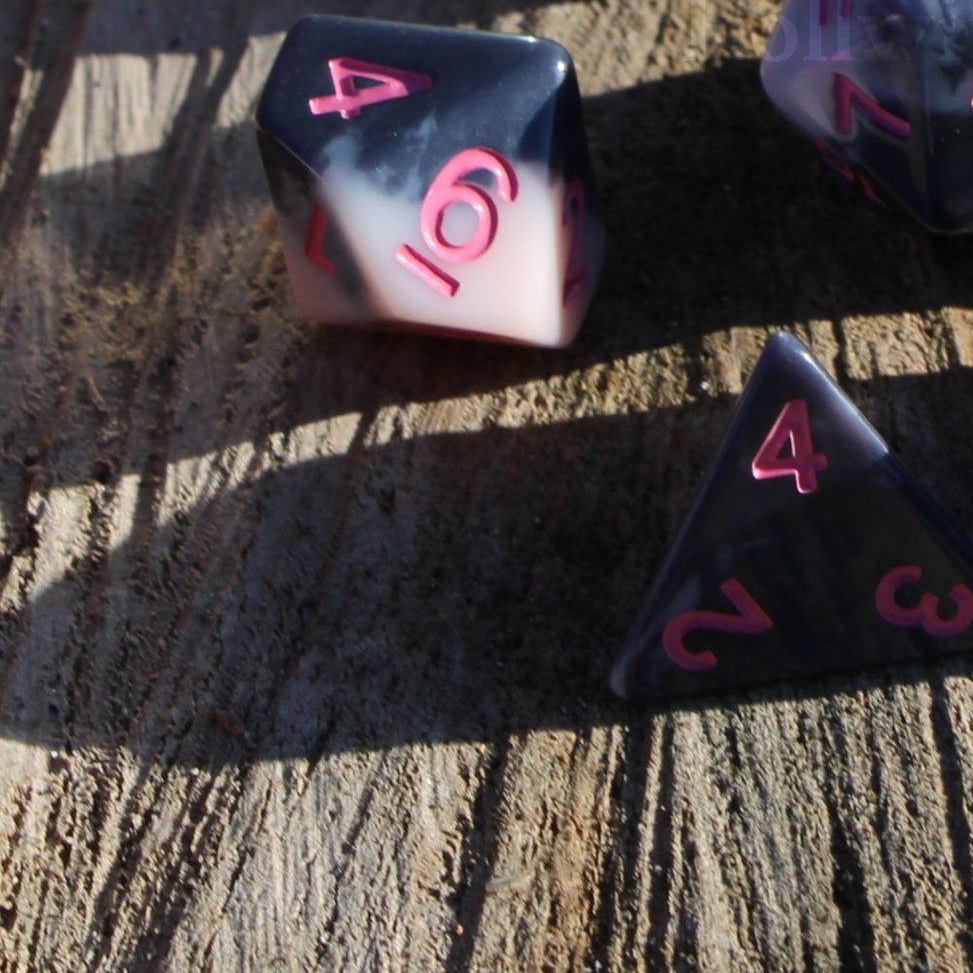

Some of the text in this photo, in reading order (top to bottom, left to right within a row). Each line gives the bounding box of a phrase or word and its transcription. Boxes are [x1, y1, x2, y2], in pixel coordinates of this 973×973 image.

[308, 57, 433, 119] 4
[752, 399, 828, 494] 4
[662, 578, 774, 671] 2
